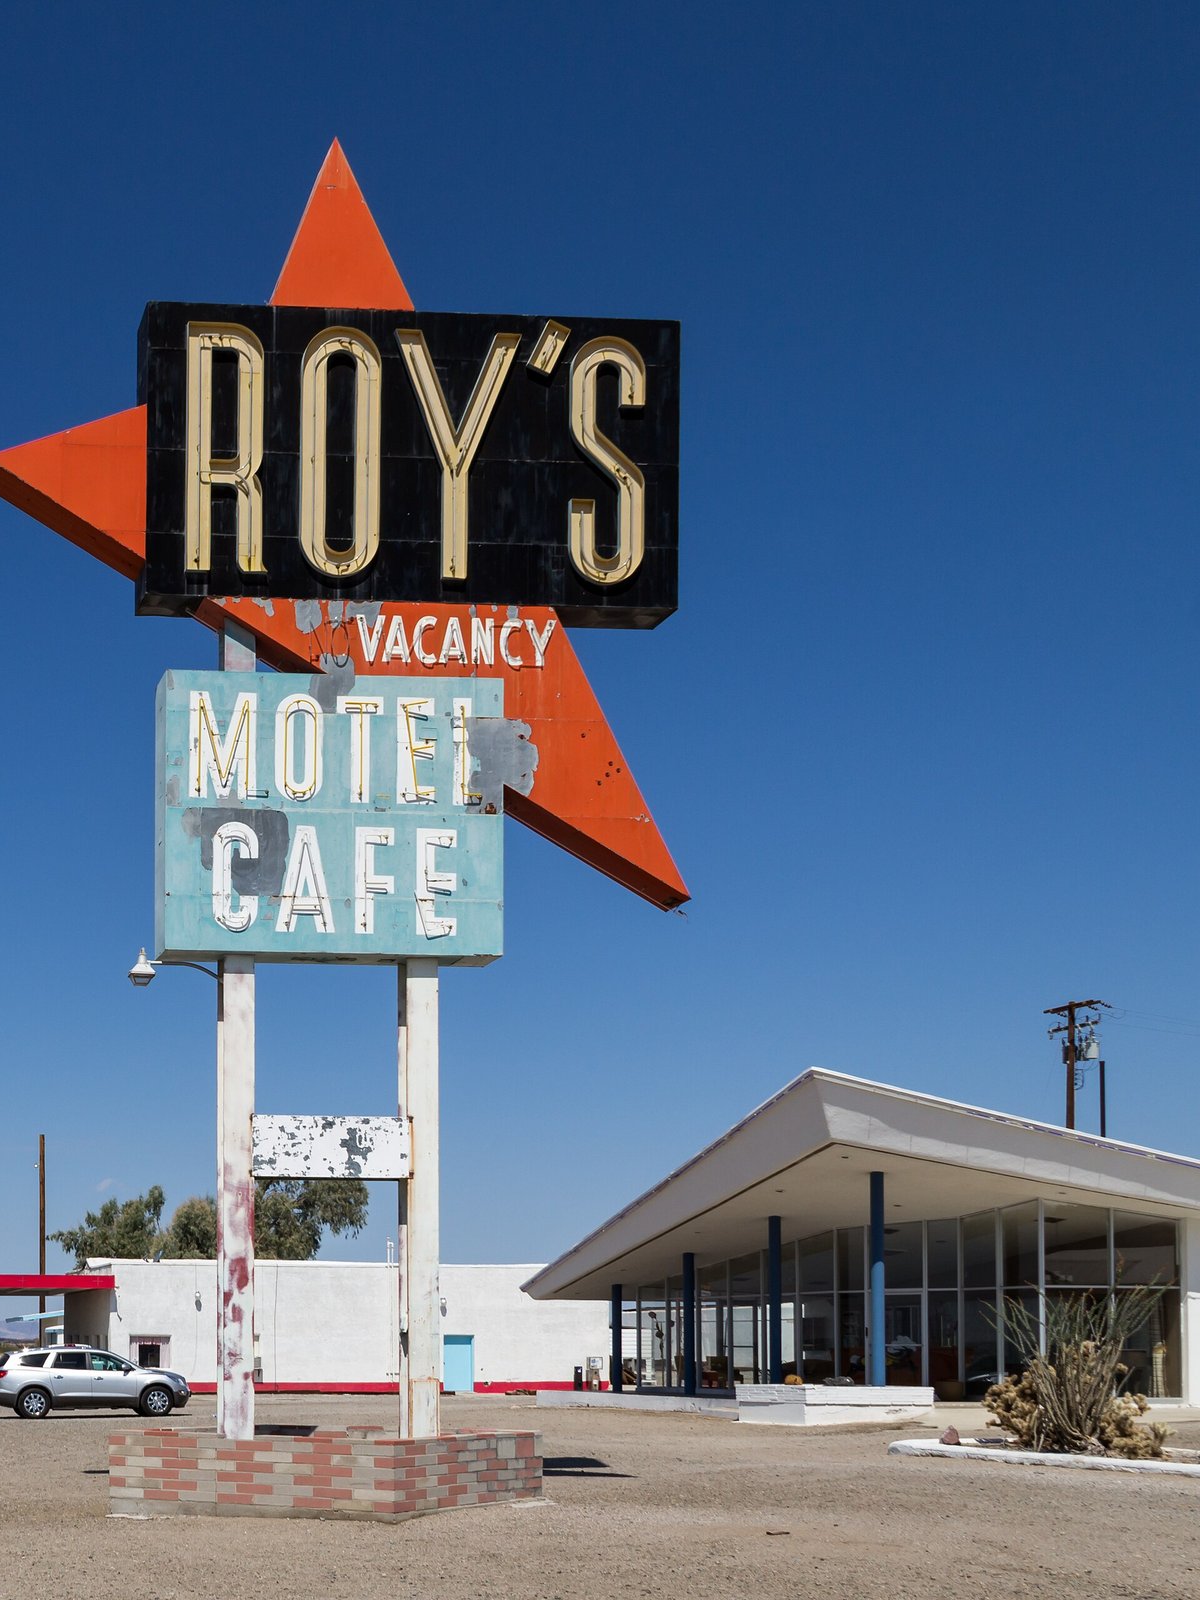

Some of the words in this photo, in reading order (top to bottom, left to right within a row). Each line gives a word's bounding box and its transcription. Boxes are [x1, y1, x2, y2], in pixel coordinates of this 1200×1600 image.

[186, 319, 646, 586] ROY'S
[356, 614, 557, 668] VACANCY
[189, 690, 482, 806] MOTEL
[212, 821, 458, 937] CAFE
